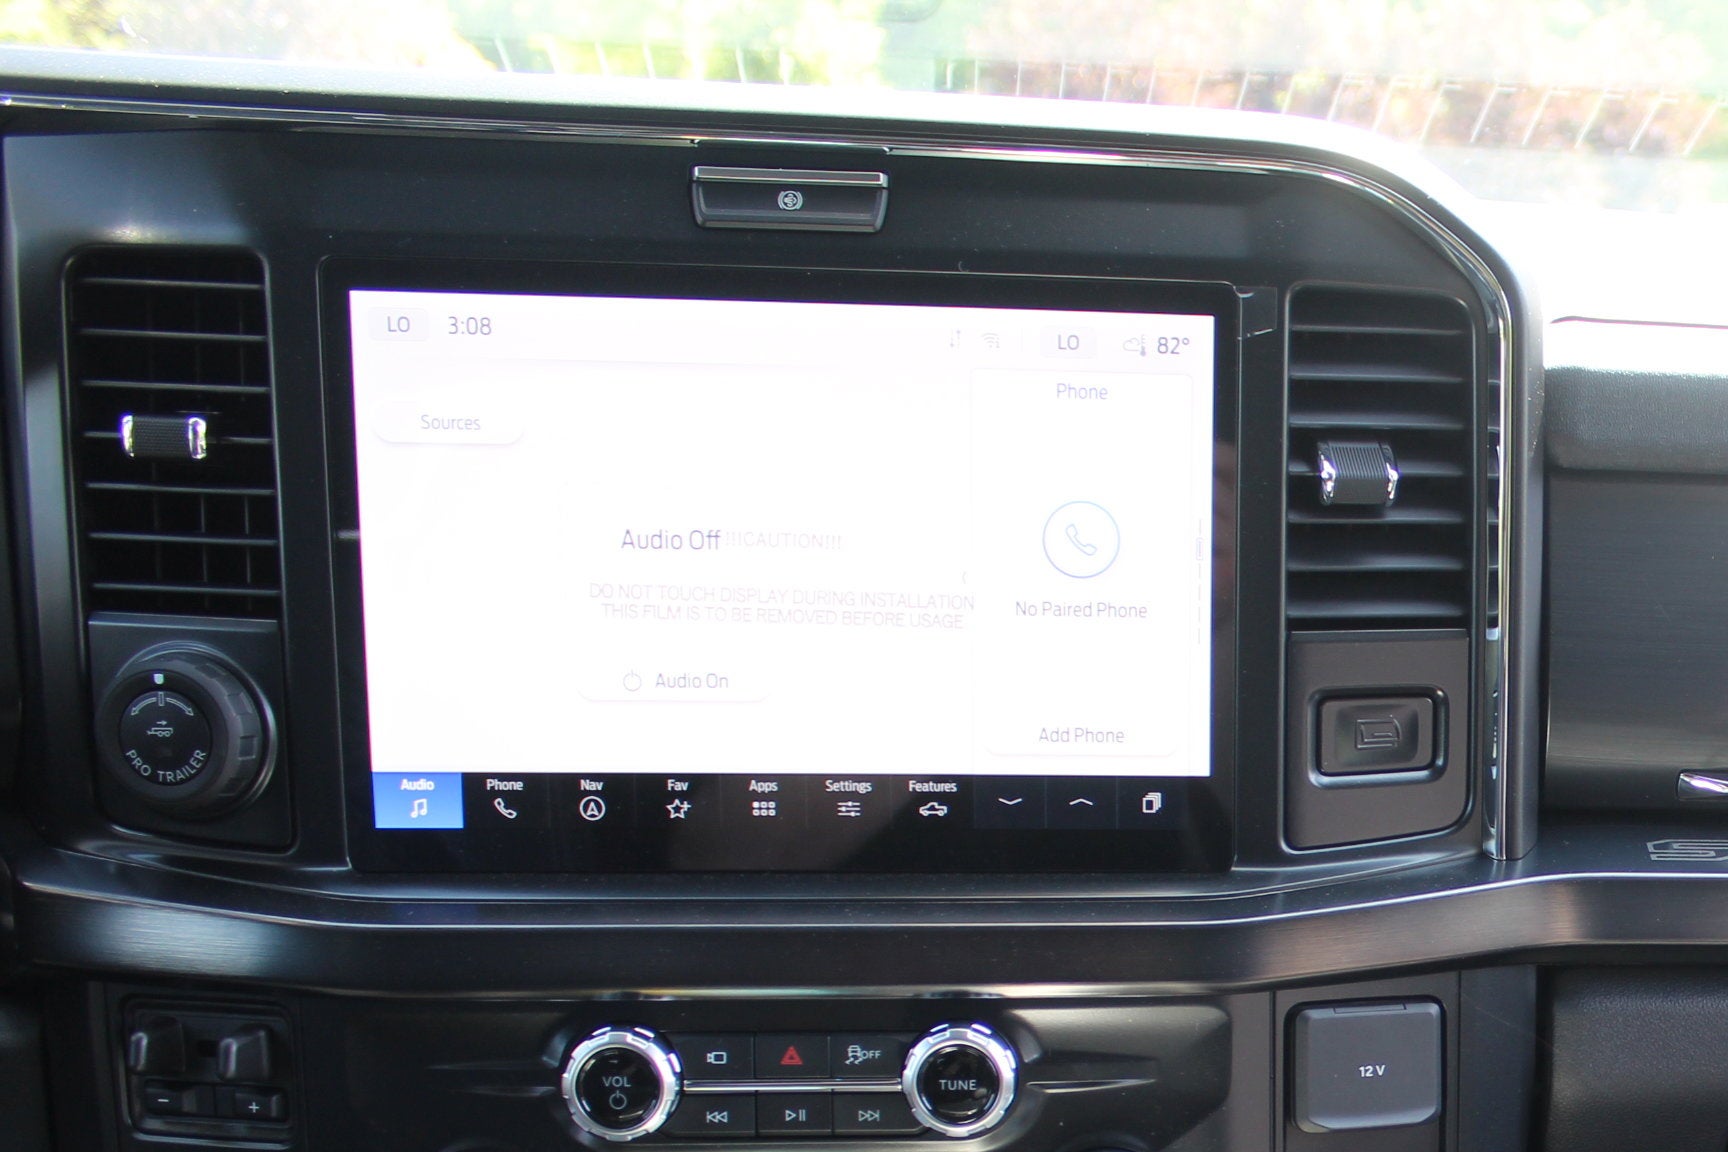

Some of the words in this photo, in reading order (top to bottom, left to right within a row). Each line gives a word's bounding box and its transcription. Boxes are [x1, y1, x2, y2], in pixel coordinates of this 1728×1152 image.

[386, 315, 411, 333] LO
[447, 316, 493, 336] 3:08
[1057, 334, 1080, 351] LO
[1156, 336, 1191, 355] 82°
[1056, 382, 1108, 401] Phone
[420, 413, 482, 432] Sources
[620, 528, 684, 551] Audio
[688, 529, 721, 551] Off
[1015, 601, 1036, 617] No
[1041, 601, 1093, 619] Paired
[1097, 602, 1148, 619] Phone
[655, 673, 702, 690] Audio
[705, 673, 730, 690] On
[1038, 728, 1071, 744] Add
[1074, 727, 1126, 744] Phone
[125, 749, 152, 777] PRO
[157, 749, 207, 783] TRAILER
[400, 778, 435, 792] Audio
[486, 779, 524, 792] Phone
[580, 779, 604, 792] Nav
[667, 779, 689, 792] Fav
[748, 779, 778, 794] Apps
[825, 779, 873, 794] Settings
[908, 780, 957, 793] Features
[860, 1049, 881, 1060] OFF
[1358, 1065, 1374, 1078] 12
[1375, 1064, 1387, 1077] V
[602, 1076, 632, 1088] VOL
[938, 1079, 977, 1091] TUNE
